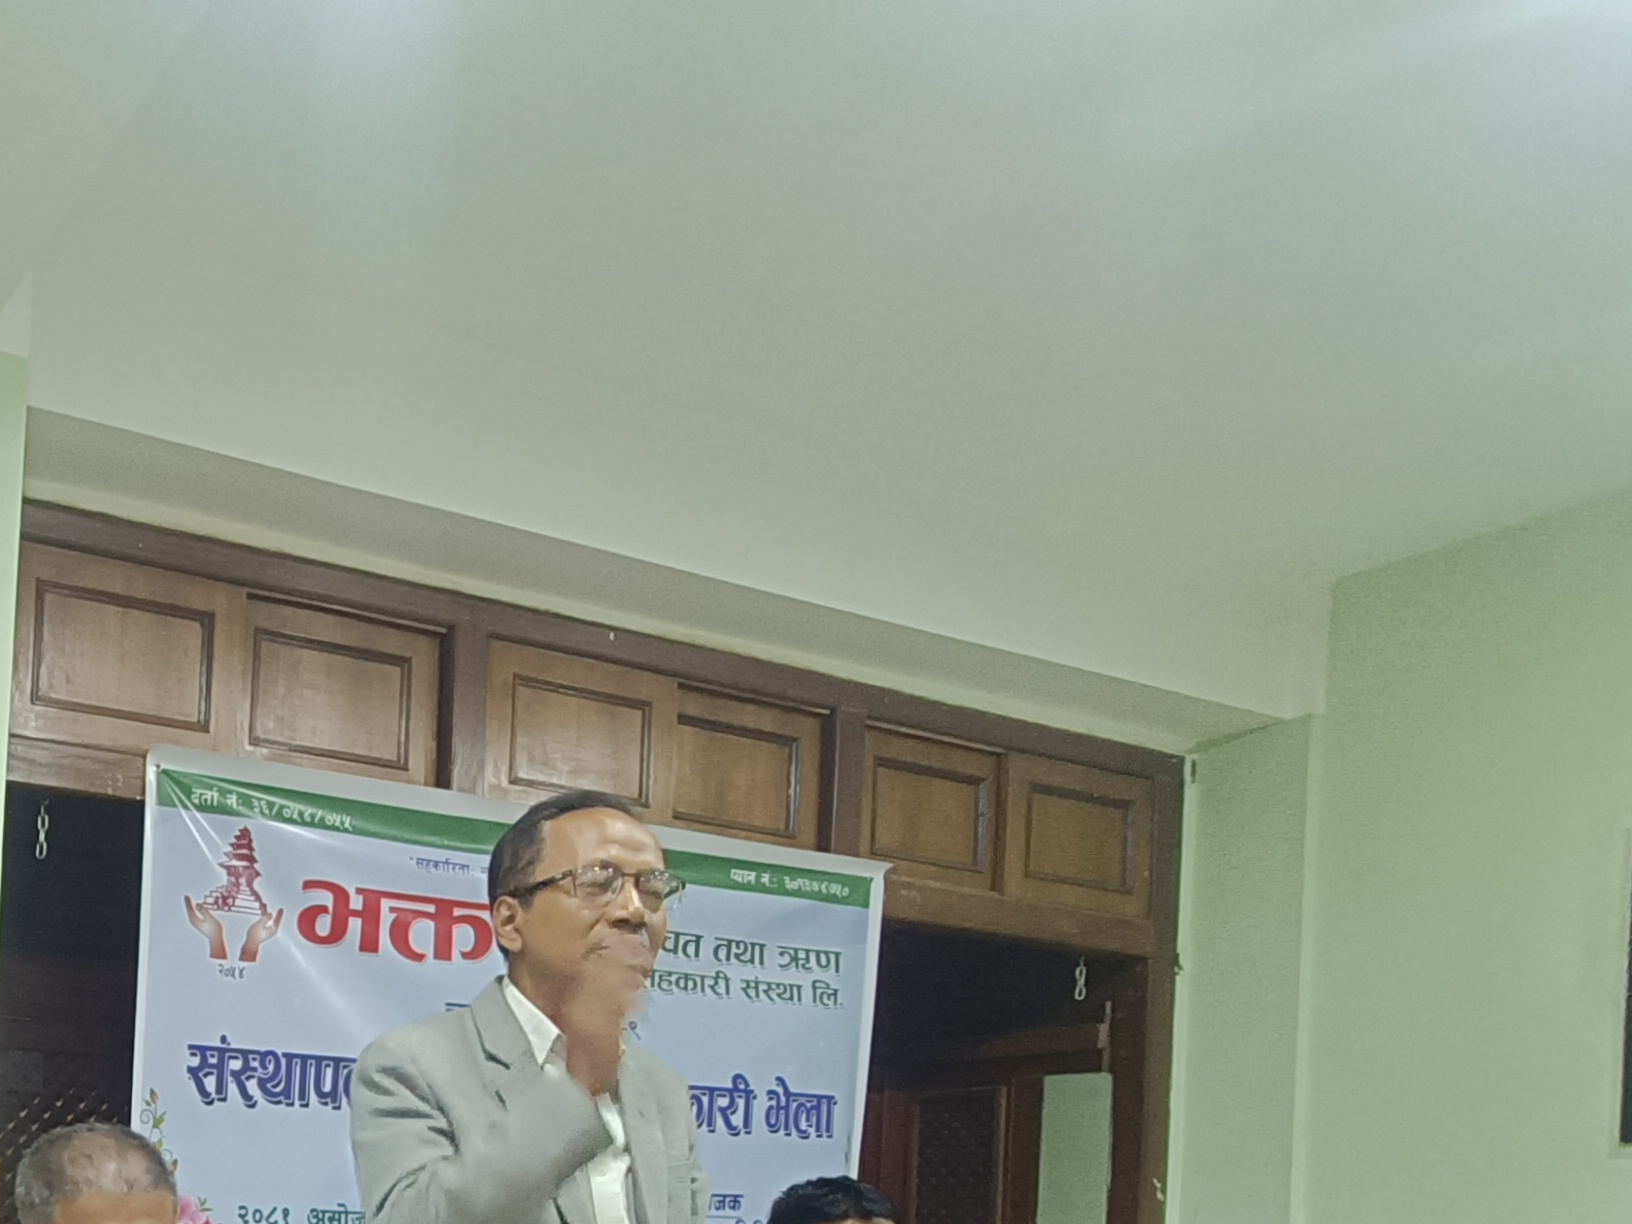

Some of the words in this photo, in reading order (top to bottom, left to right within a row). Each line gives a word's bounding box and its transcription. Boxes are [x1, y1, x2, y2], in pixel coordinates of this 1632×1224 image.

[190, 786, 220, 807] दर्ता
[712, 935, 767, 969] तथा
[739, 976, 804, 1005] संस्था
